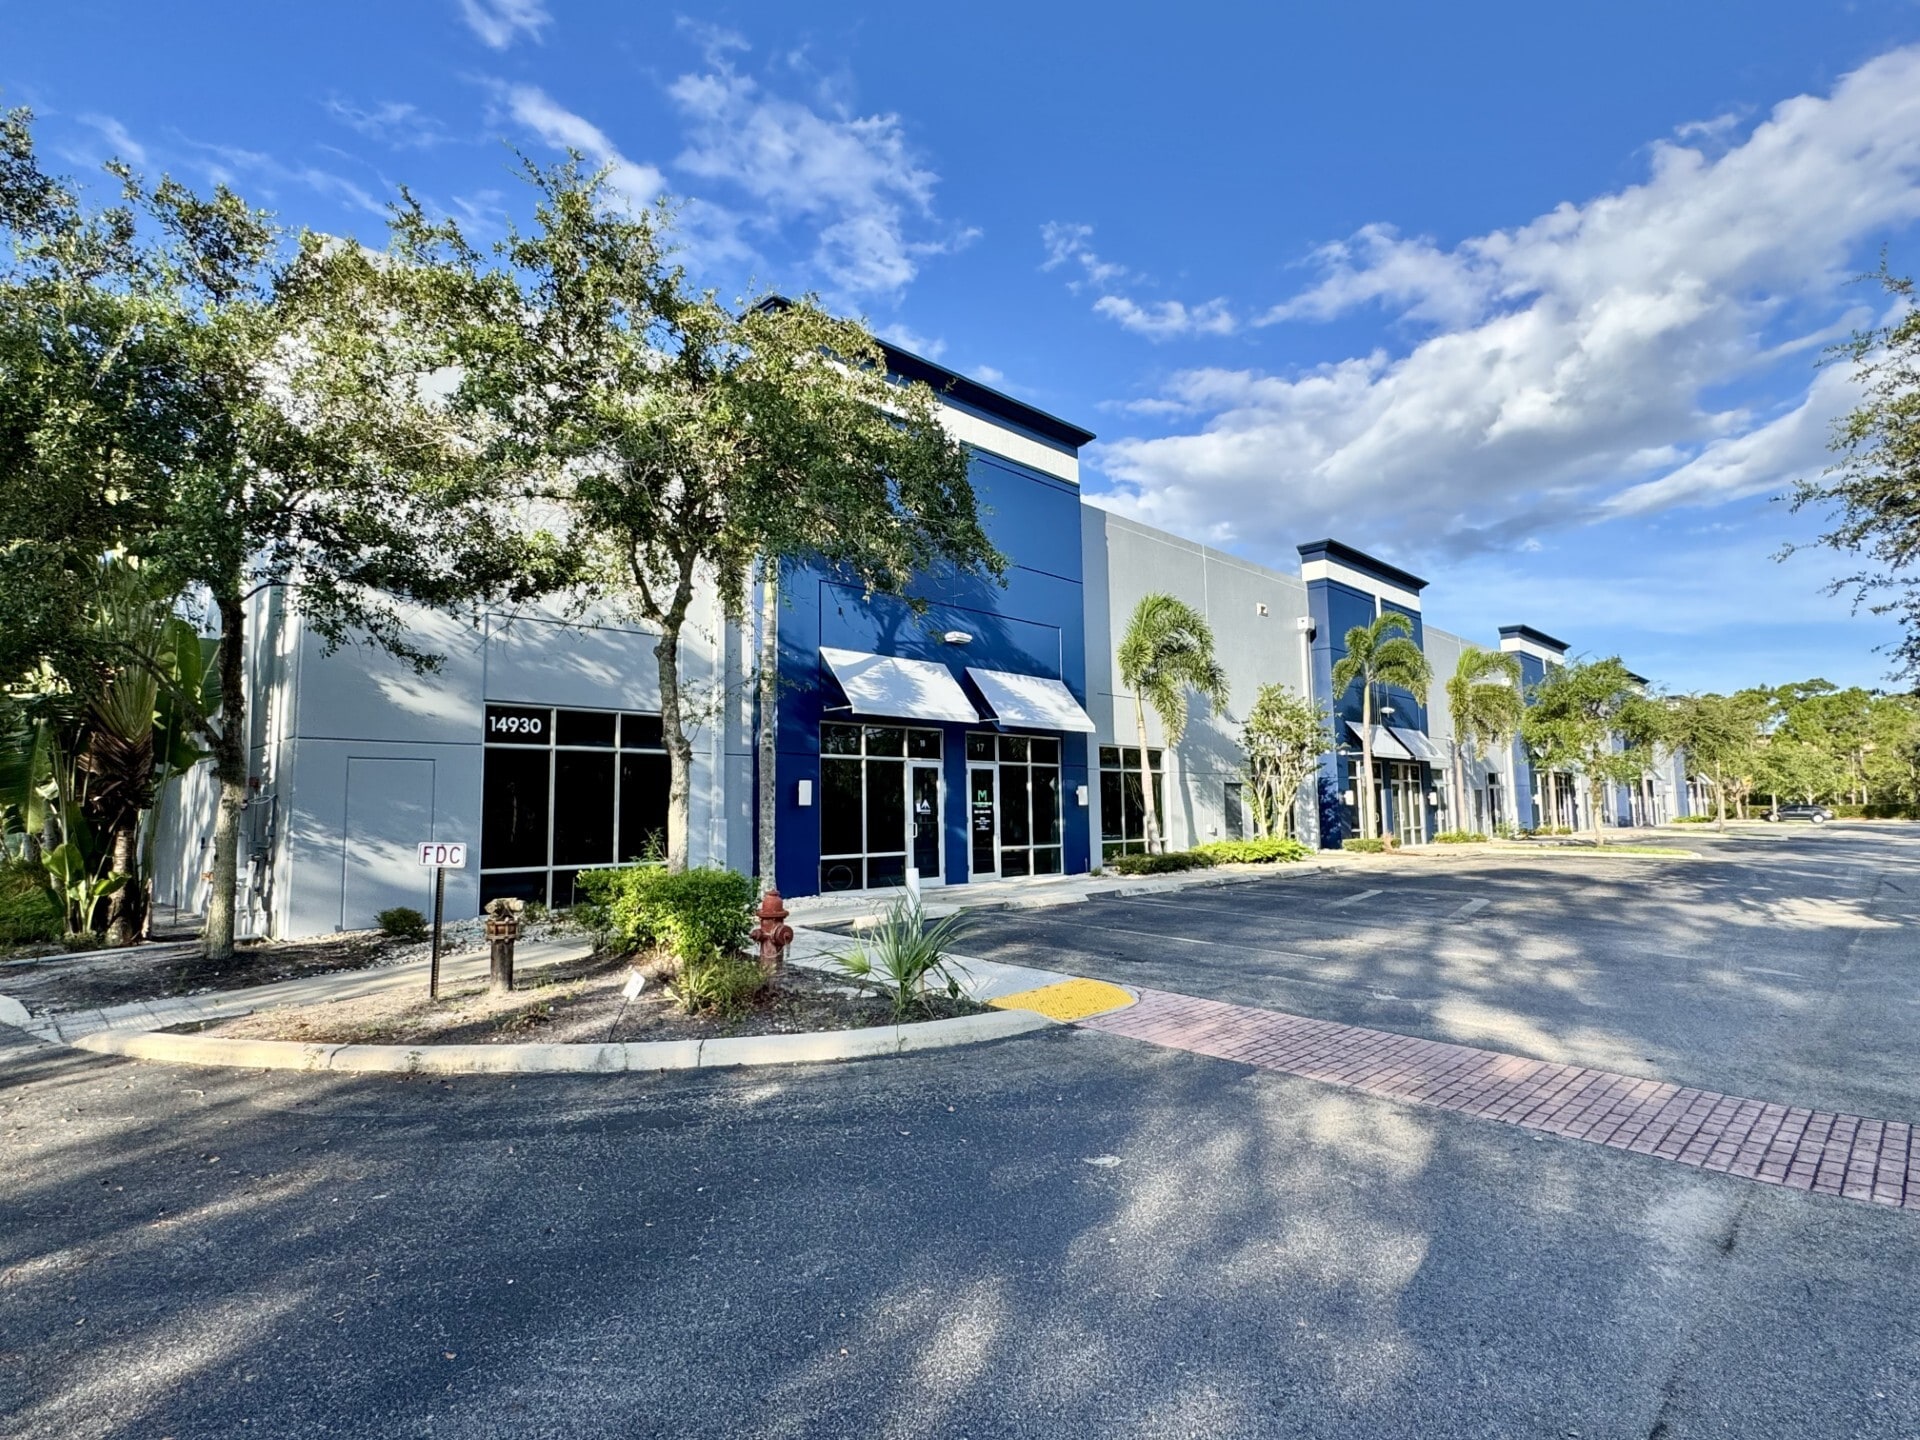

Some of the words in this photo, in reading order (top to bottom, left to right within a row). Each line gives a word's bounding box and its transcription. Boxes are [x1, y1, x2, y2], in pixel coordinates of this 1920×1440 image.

[489, 716, 542, 734] 14930
[976, 743, 985, 752] 17
[977, 789, 988, 801] M
[422, 845, 461, 865] FDC
